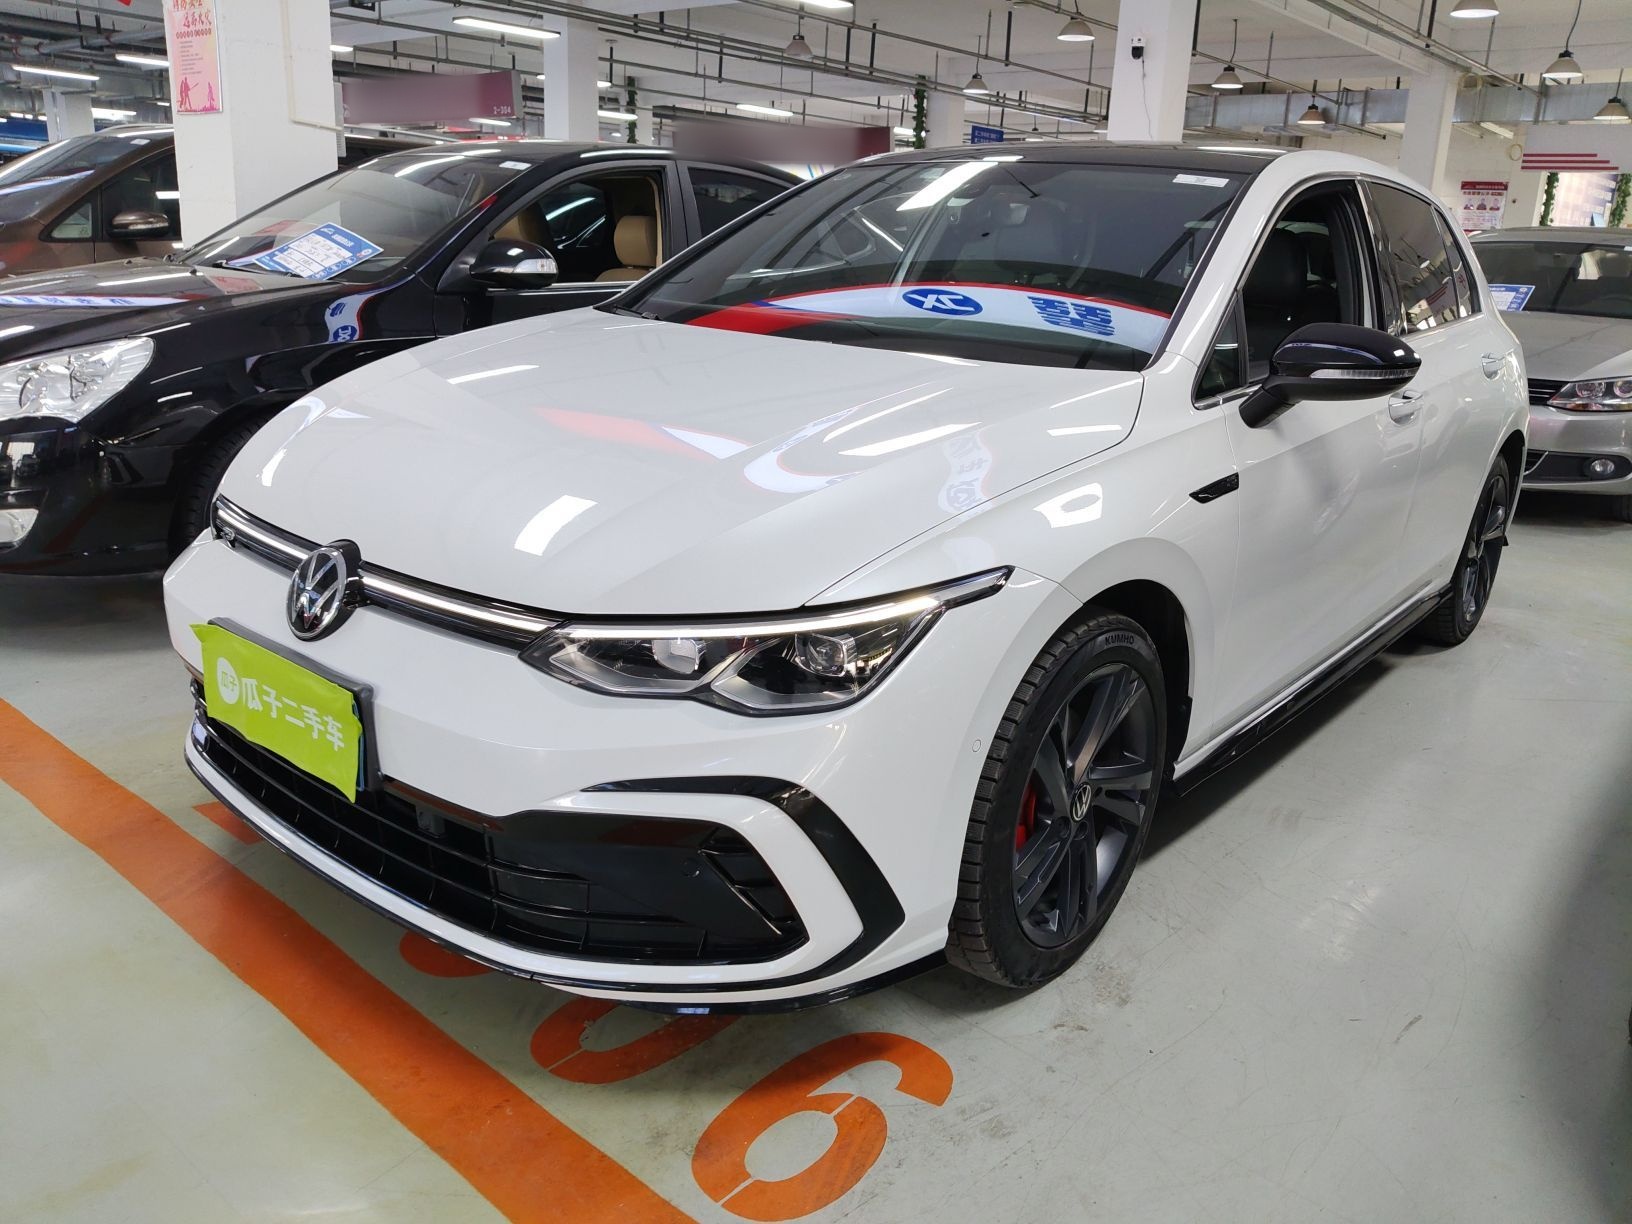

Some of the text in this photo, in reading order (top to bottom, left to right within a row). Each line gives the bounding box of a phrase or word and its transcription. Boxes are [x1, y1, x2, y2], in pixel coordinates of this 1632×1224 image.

[1105, 631, 1135, 646] KUMHO
[241, 678, 344, 751] 瓜子二手车
